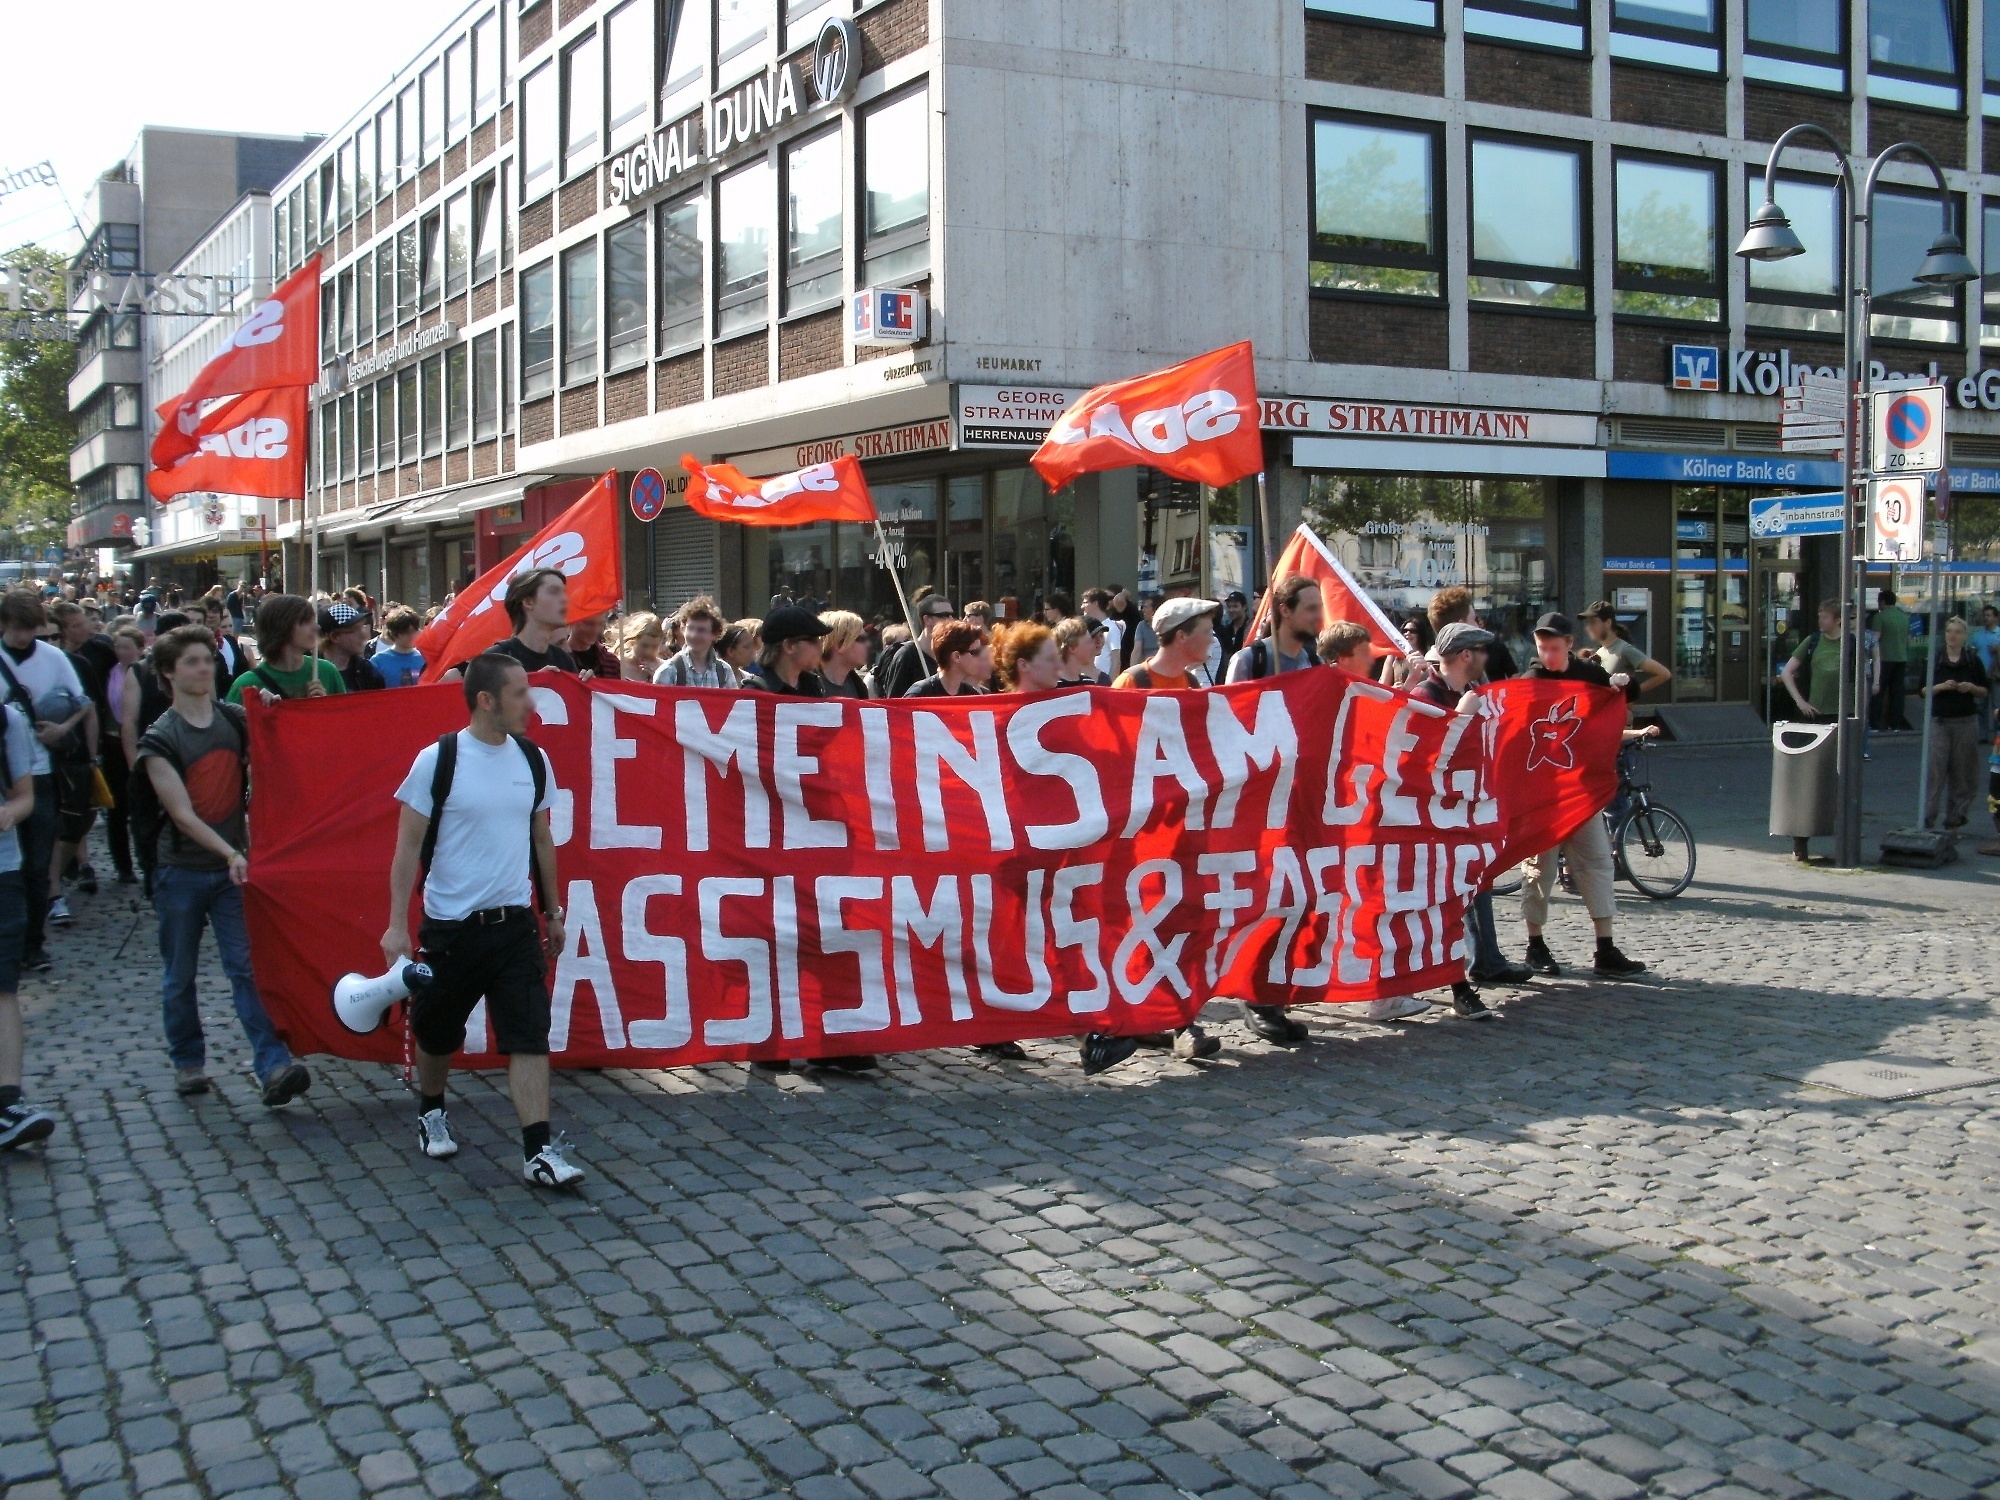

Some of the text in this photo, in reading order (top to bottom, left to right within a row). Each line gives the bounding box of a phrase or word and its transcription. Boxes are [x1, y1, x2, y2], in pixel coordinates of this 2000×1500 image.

[610, 62, 798, 207] SIGNAL IDUNA
[413, 320, 449, 352] Finanzen
[997, 390, 1065, 405] GEORG
[1957, 368, 2000, 410] eG
[1328, 403, 1530, 439] STRATHMANN
[796, 440, 844, 467] GEORG
[1683, 459, 1795, 481] Kölner Bank eG
[1606, 561, 1628, 570] Kölner
[1629, 561, 1645, 570] Bank
[1112, 857, 1192, 1005] &
